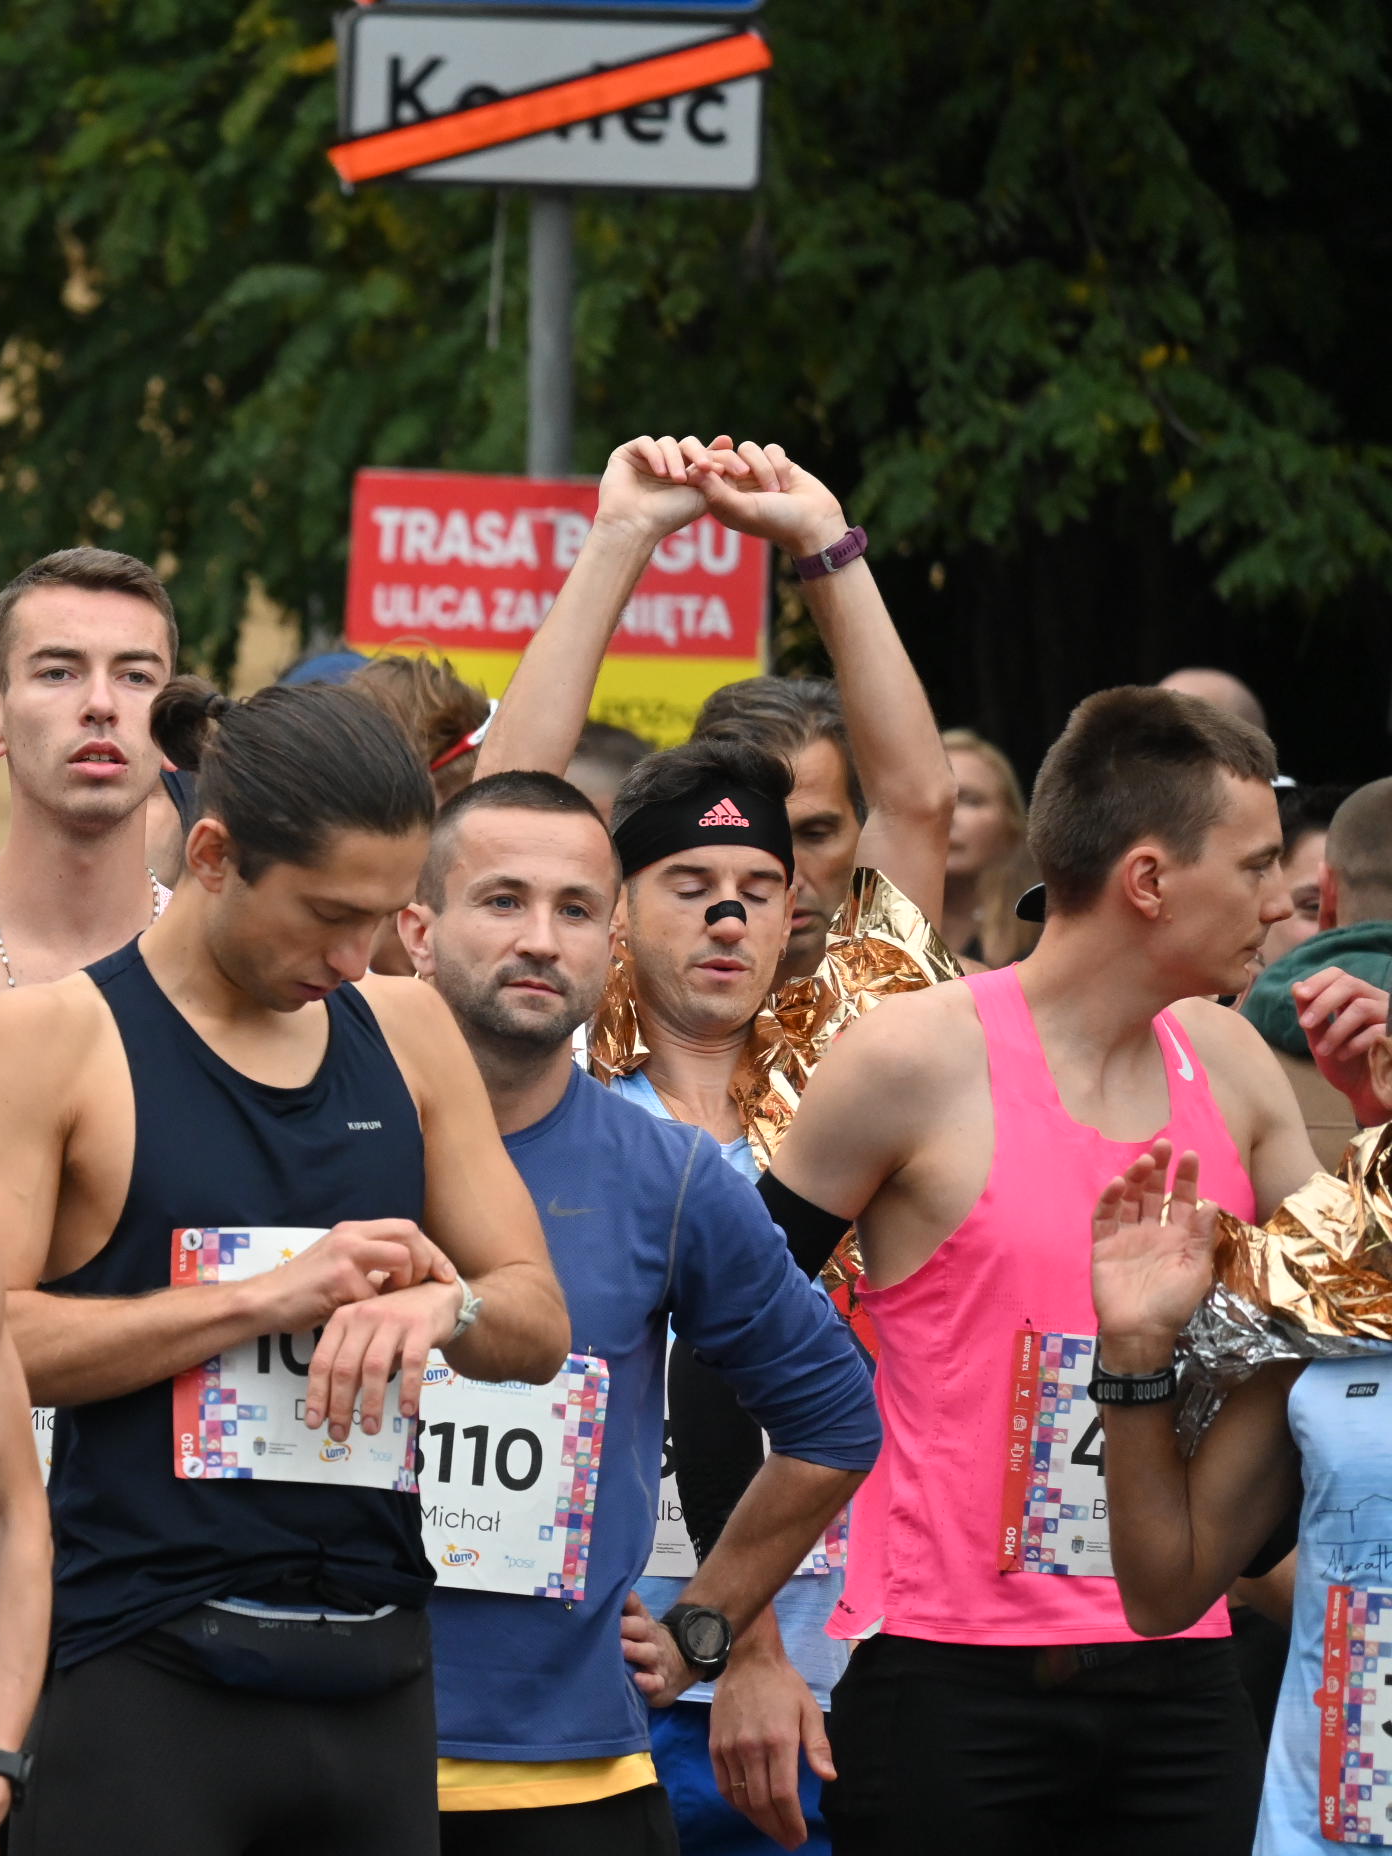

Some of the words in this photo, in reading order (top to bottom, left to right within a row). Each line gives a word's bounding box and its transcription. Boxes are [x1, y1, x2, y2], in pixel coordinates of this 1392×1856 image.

[372, 505, 538, 570] TRASA
[552, 511, 743, 577] BGU
[371, 583, 486, 632] ULICA
[698, 815, 750, 828] adidas
[419, 1504, 502, 1533] Michał
[1004, 1526, 1017, 1556] M30
